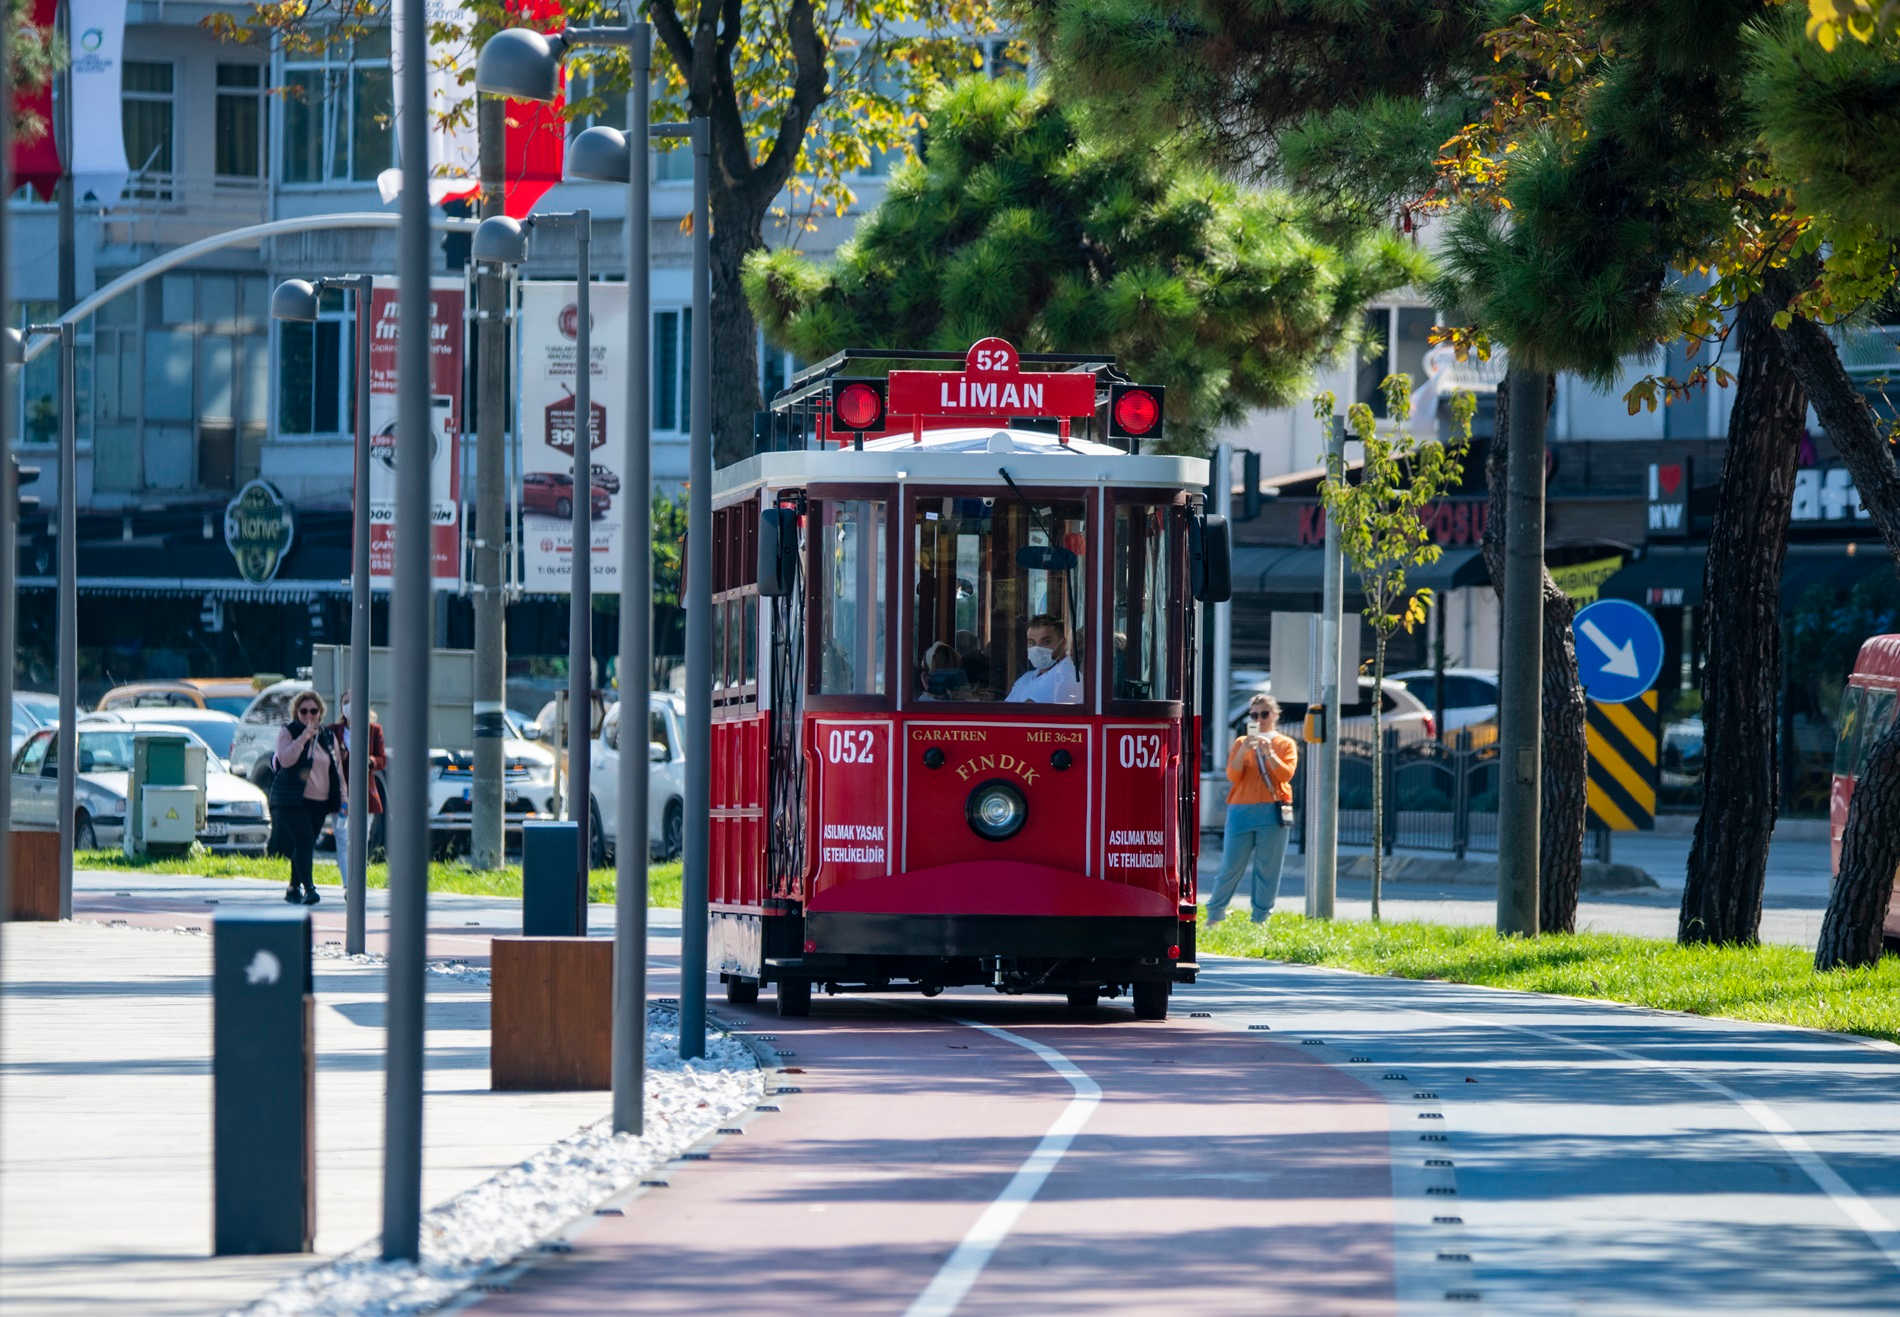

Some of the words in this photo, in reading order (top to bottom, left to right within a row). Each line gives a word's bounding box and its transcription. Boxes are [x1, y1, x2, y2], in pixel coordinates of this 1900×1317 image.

[976, 350, 1009, 371] 52
[940, 376, 1044, 409] LİMAN
[1649, 503, 1684, 529] NW
[829, 729, 874, 764] 052
[912, 730, 987, 742] GARATREN
[1026, 730, 1052, 743] MİE
[1054, 732, 1083, 743] 36-21
[1119, 734, 1161, 769] 052
[955, 753, 1041, 787] FINDIK
[823, 824, 855, 840] ASILMAK
[855, 825, 884, 841] YASAK
[1109, 830, 1145, 845] ASILMAK
[831, 845, 885, 863] TEHLİKELİDİR
[1108, 853, 1120, 868] VE
